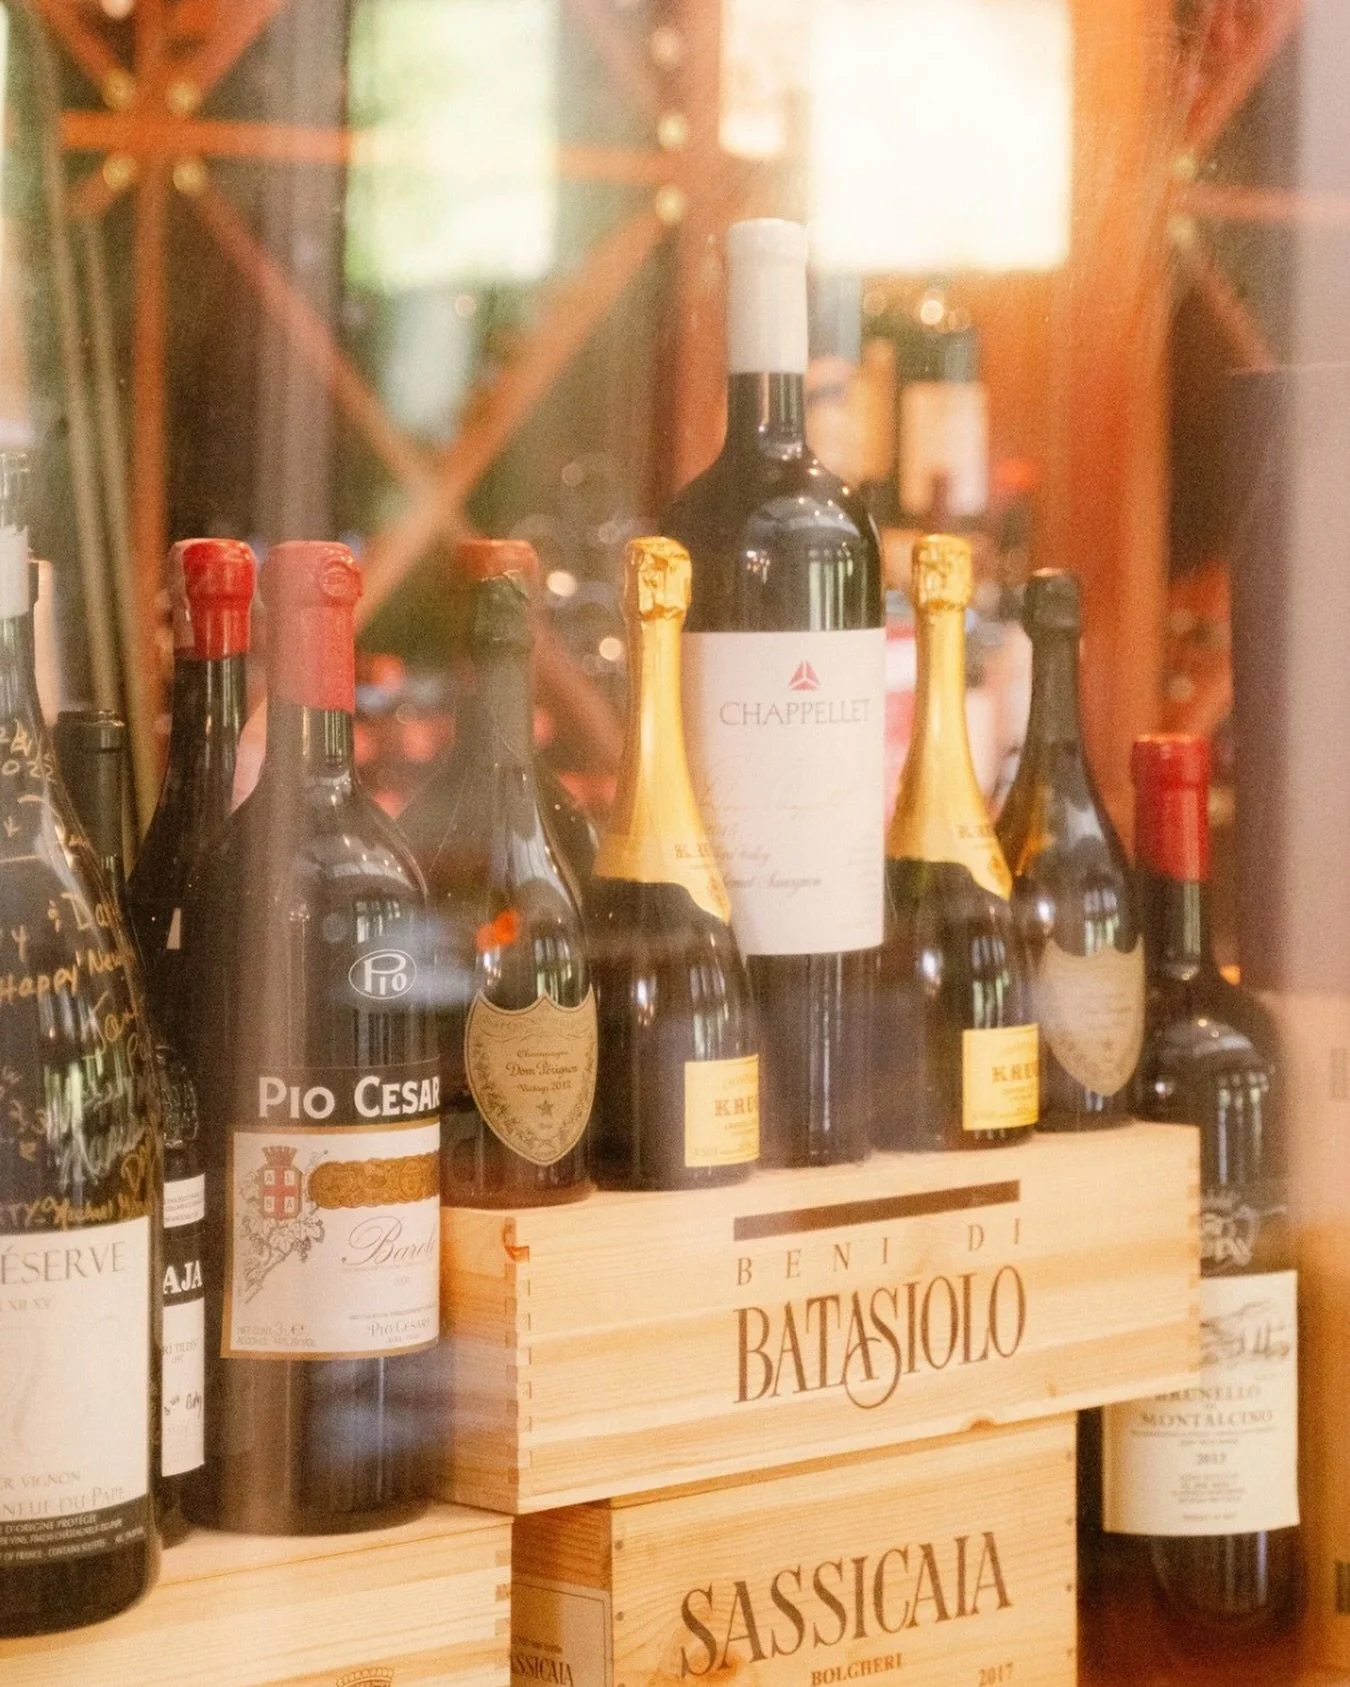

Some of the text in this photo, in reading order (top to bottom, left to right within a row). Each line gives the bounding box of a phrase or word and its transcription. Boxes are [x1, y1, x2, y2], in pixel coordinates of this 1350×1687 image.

[719, 698, 870, 726] CHAPPELLET
[506, 1061, 535, 1077] Dom
[0, 1240, 126, 1285] ÉSERVE
[737, 1218, 1021, 1286] BENI DI
[163, 1260, 203, 1294] AJA
[733, 1264, 1026, 1410] BATASIOLO
[1140, 1410, 1274, 1428] MONTALCINO
[680, 1531, 1013, 1680] SASSICAIA
[811, 1652, 1015, 1687] BOLGHERI 2017
